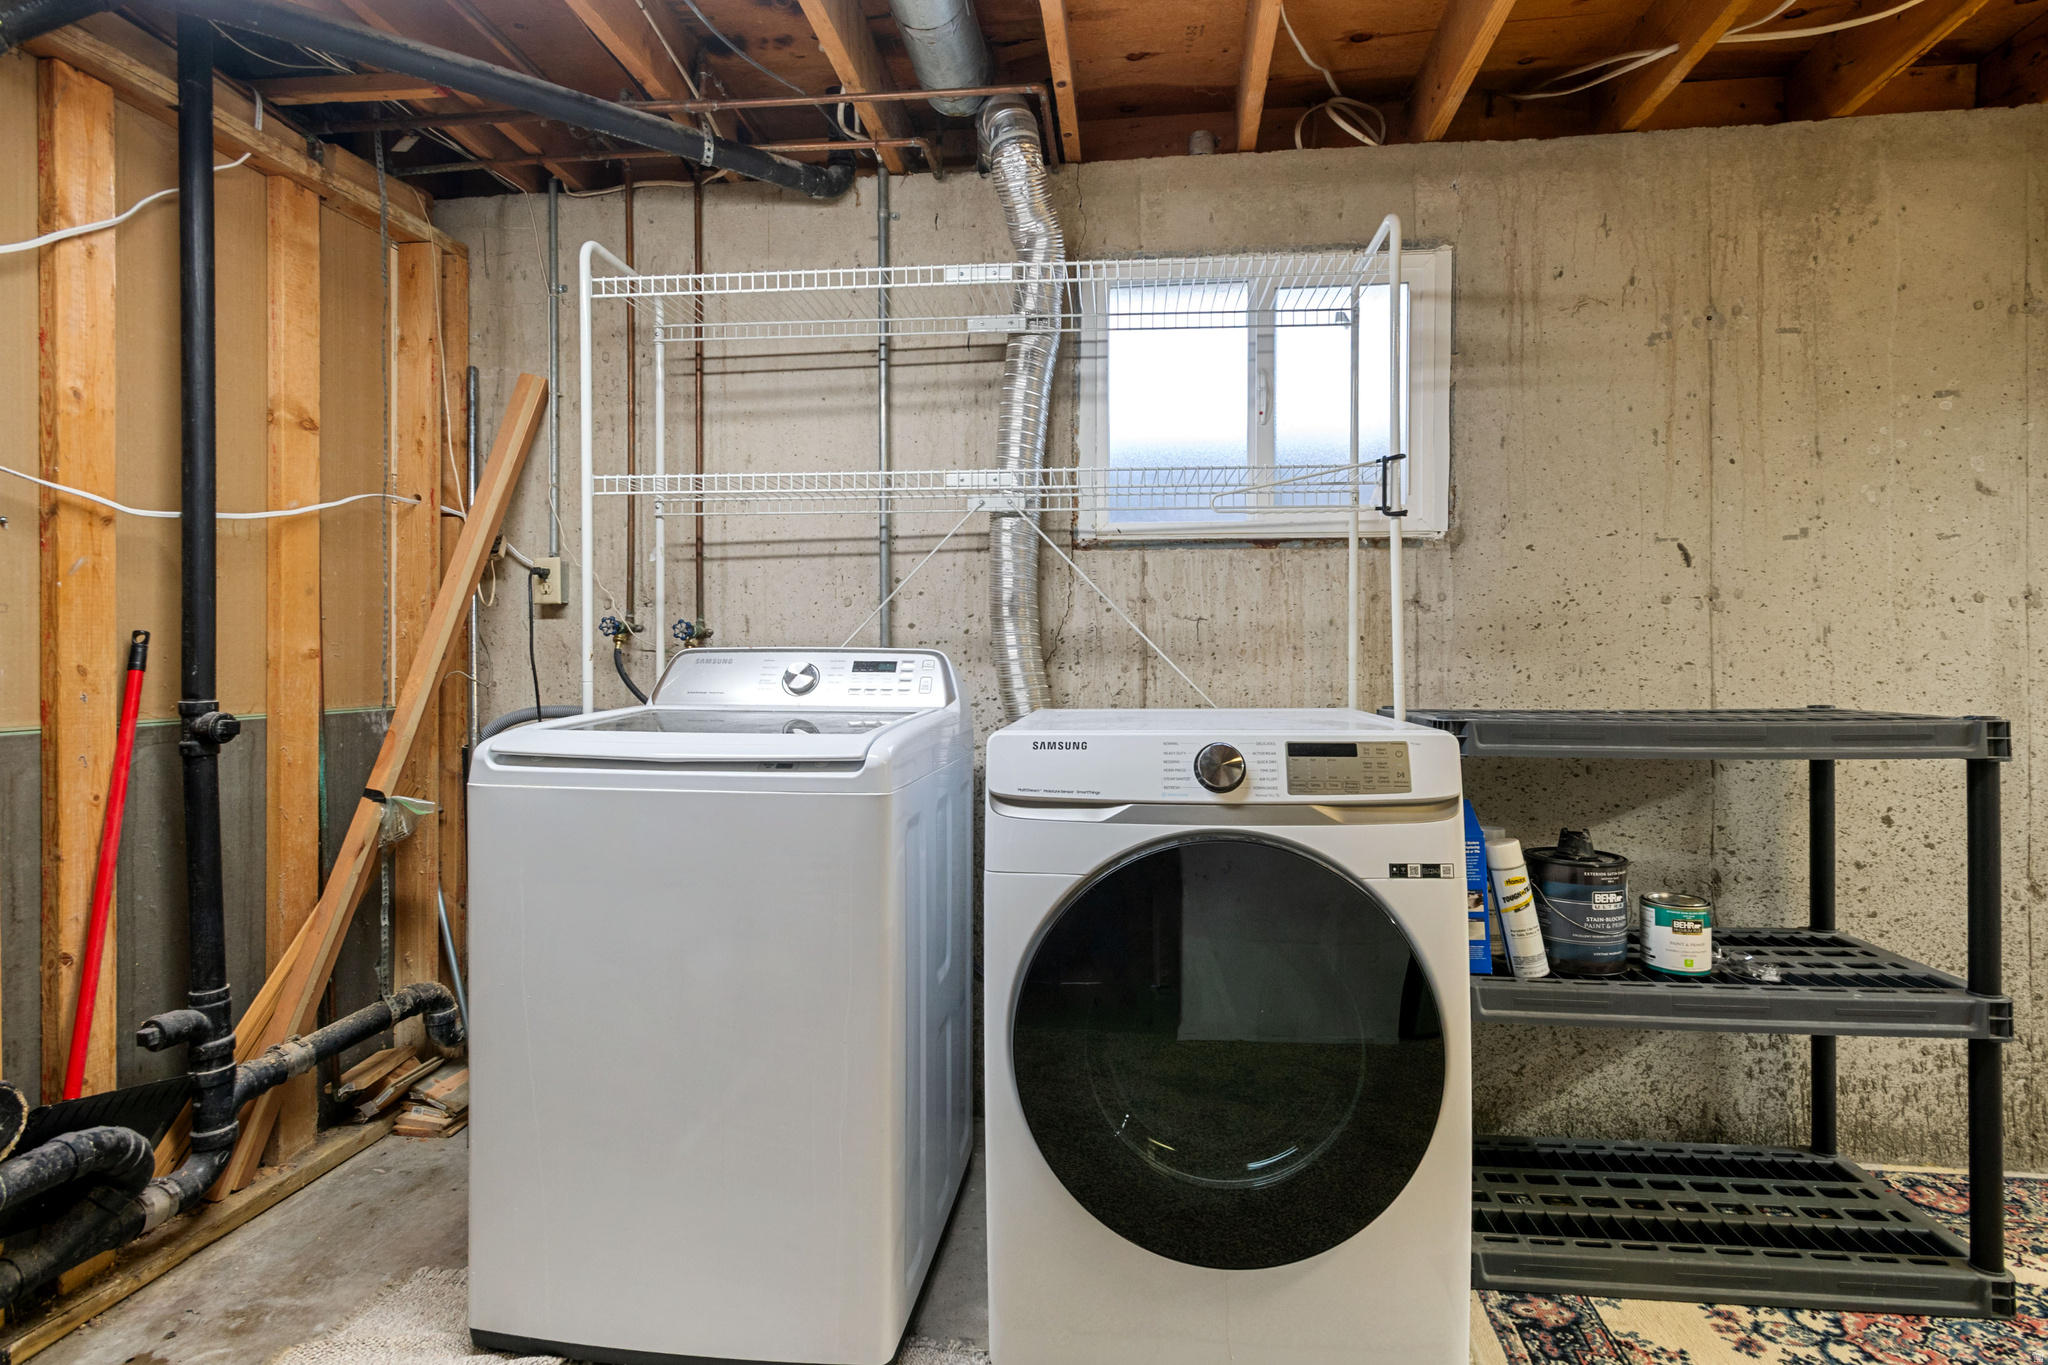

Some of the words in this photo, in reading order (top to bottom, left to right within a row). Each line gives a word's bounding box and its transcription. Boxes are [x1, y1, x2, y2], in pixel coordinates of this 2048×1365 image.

[1032, 741, 1088, 750] SAMSUNG
[1506, 878, 1526, 886] Homax
[1594, 893, 1617, 903] BEHR
[1673, 920, 1695, 929] BEHR
